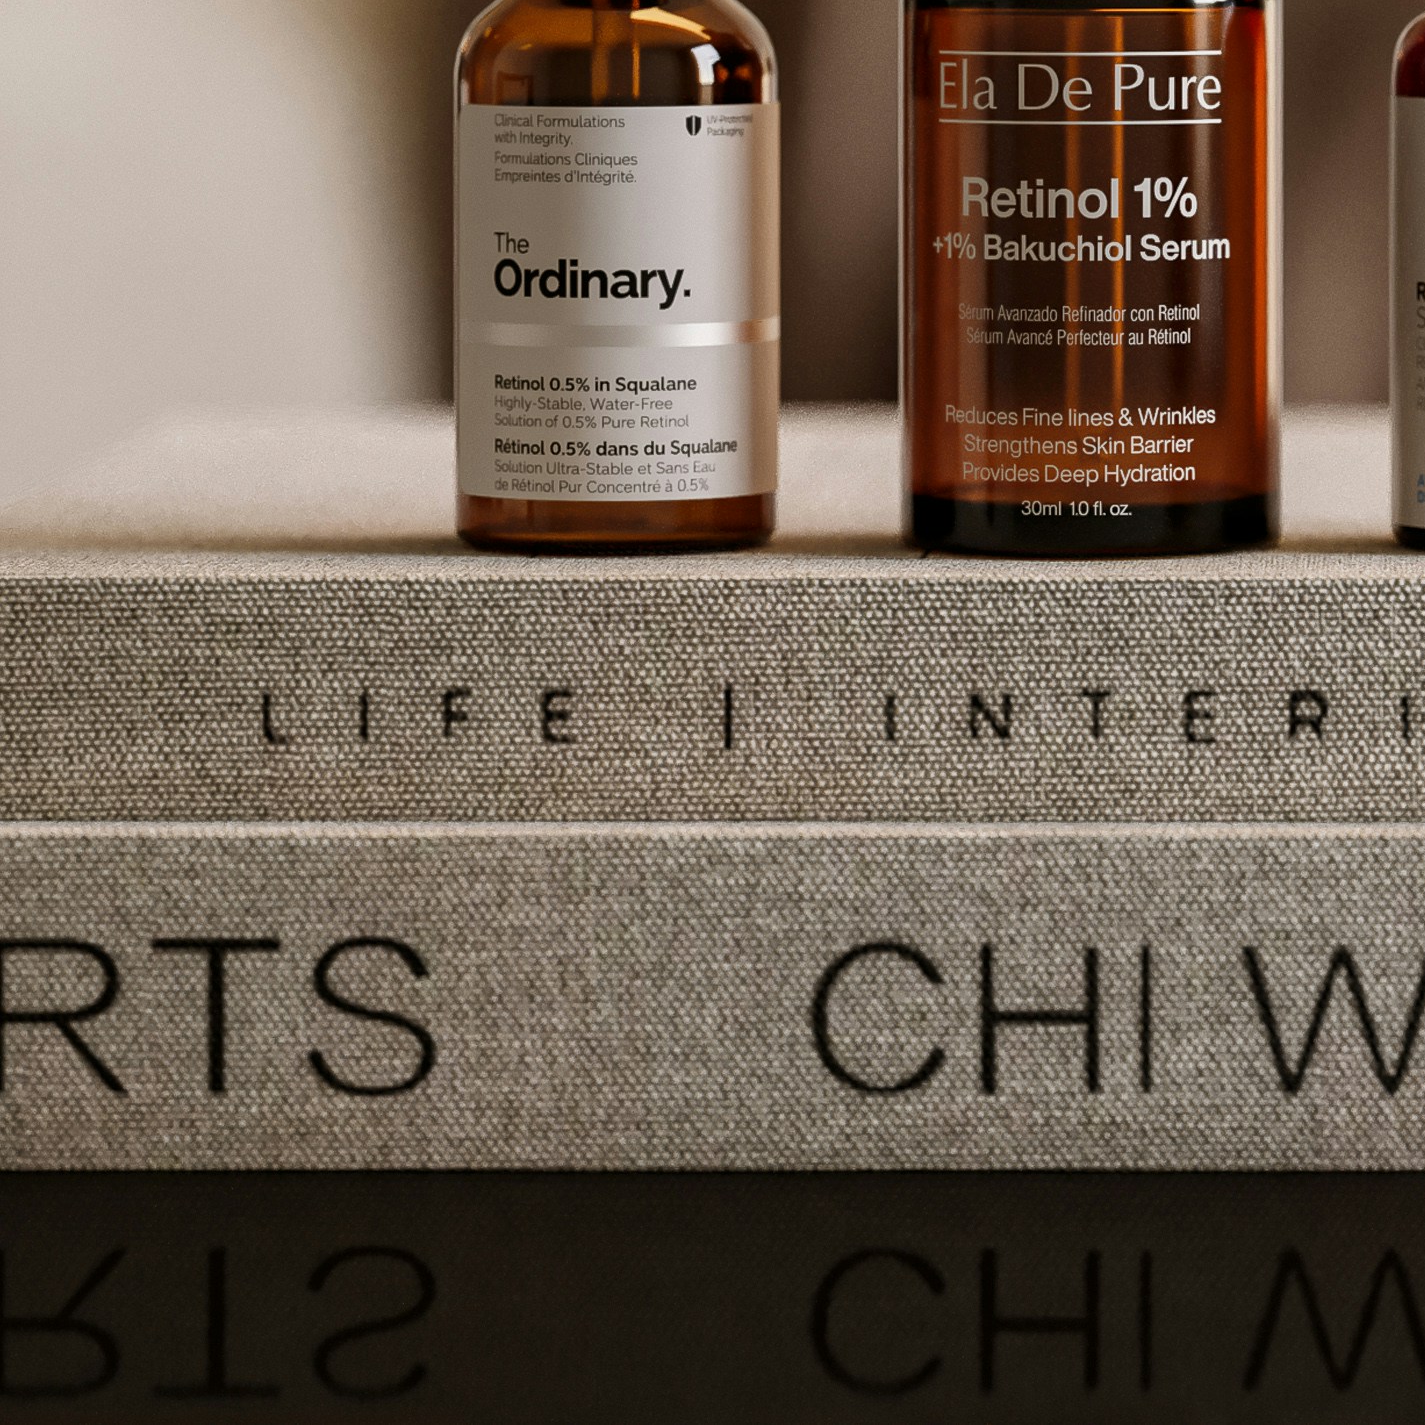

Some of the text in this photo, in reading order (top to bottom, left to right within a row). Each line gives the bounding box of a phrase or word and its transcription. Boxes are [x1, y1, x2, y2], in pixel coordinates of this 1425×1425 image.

[939, 58, 1221, 111] Ela De Pure
[494, 113, 625, 128] Clinical Formulations
[494, 132, 573, 147] with Integrity.
[494, 151, 638, 169] Formulations Cliniques
[494, 169, 637, 186] Empreintes d'Intégrité.
[962, 176, 1198, 219] Retinol 1%
[494, 231, 529, 254] The
[933, 232, 1231, 262] +1% Bakuchiol Serum
[494, 258, 691, 310] Ordinary.
[958, 303, 1200, 323] Sérum Avanzado Refinador con Retinol
[966, 326, 1191, 346] Sérum Avancé Perfecteur au Rétinol
[494, 374, 697, 395] Retinol 0.5% in Squalane
[494, 395, 673, 413] Highly-Stable, Water-Free
[494, 413, 689, 429] Solution of 0.5% Pure Retinol
[945, 404, 1216, 426] Reduces Fine lines & Wrinkles
[494, 438, 737, 459] Rétinol 0.5% dans du Squalane
[964, 434, 1194, 458] Strengthens Skin Barrier
[494, 459, 716, 476] Solution Ultra-Stable et Sans Eau
[962, 462, 1196, 487] Provides Deep Hydration
[494, 477, 709, 494] de Rétinol Pur Concentré à 0.5%
[1021, 501, 1132, 516] 30ml 1.0 fl. oz.
[262, 689, 574, 745] LIFE
[0, 936, 437, 1097] RTS
[811, 941, 1153, 1096] CHI
